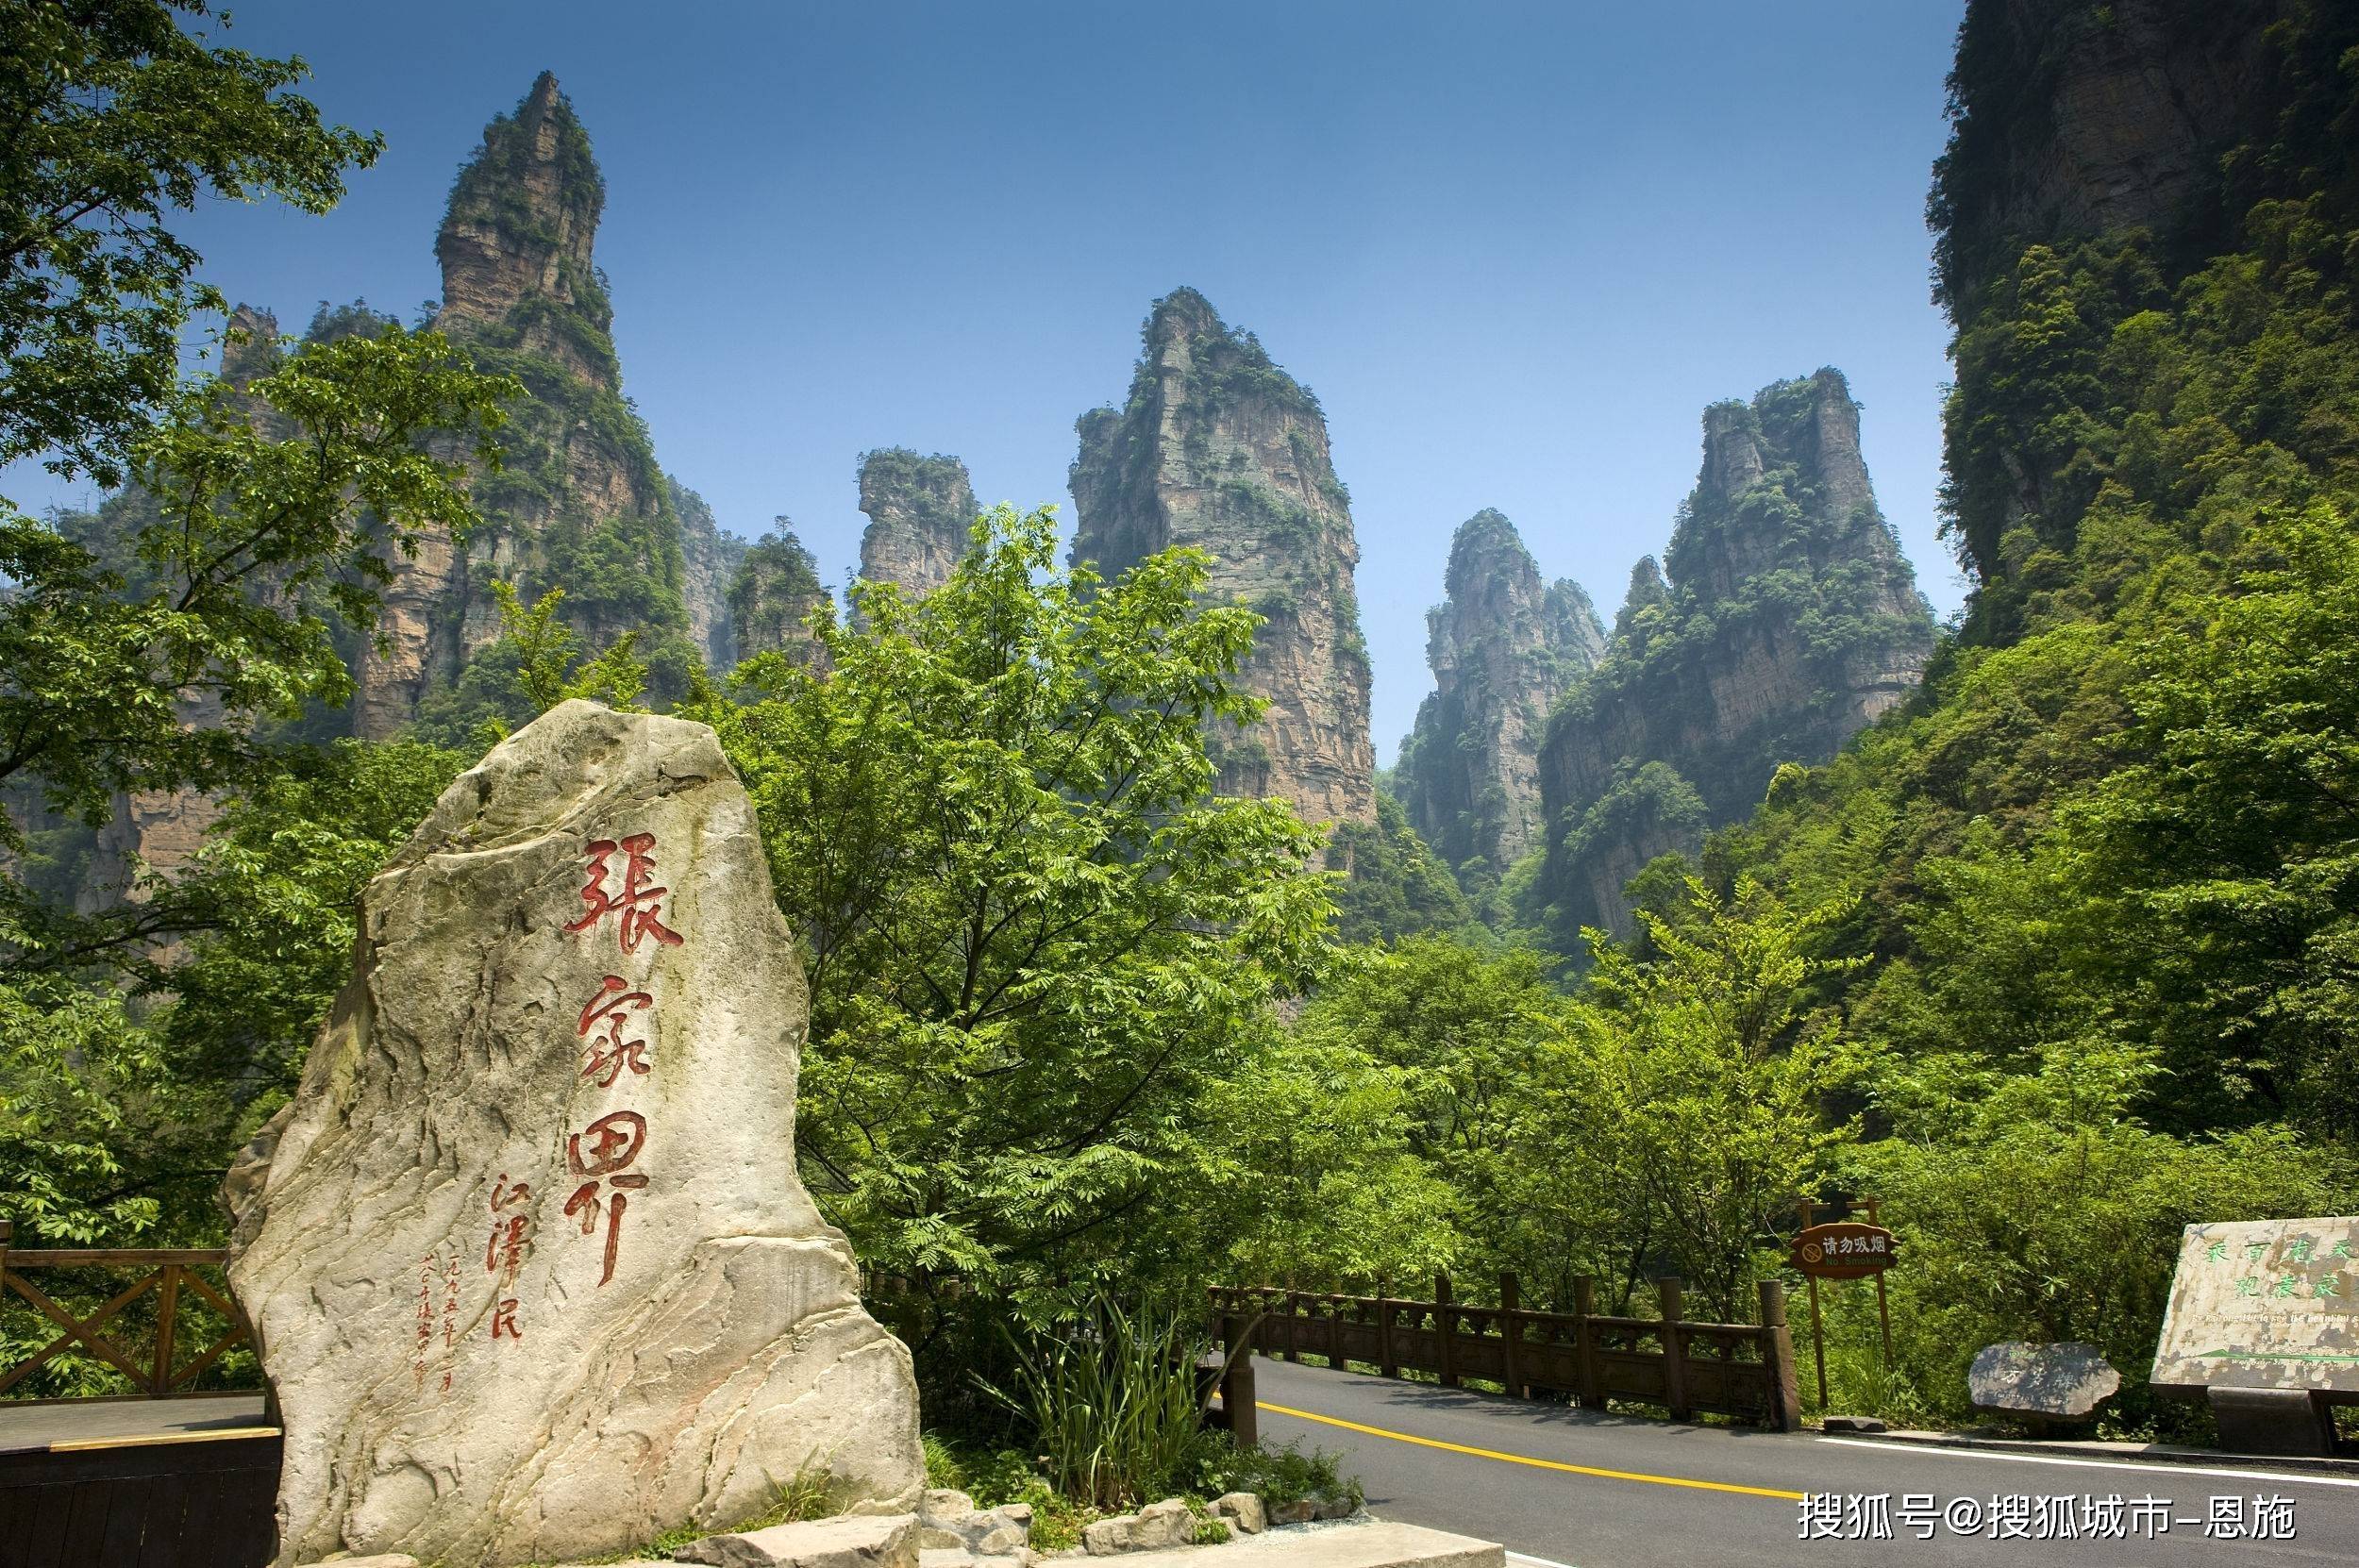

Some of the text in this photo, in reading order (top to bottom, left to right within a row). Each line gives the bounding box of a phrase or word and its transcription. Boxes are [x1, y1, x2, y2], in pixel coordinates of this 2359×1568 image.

[1822, 1235, 1885, 1256] 请勿吸烟
[1826, 1256, 1887, 1267] No Smoking
